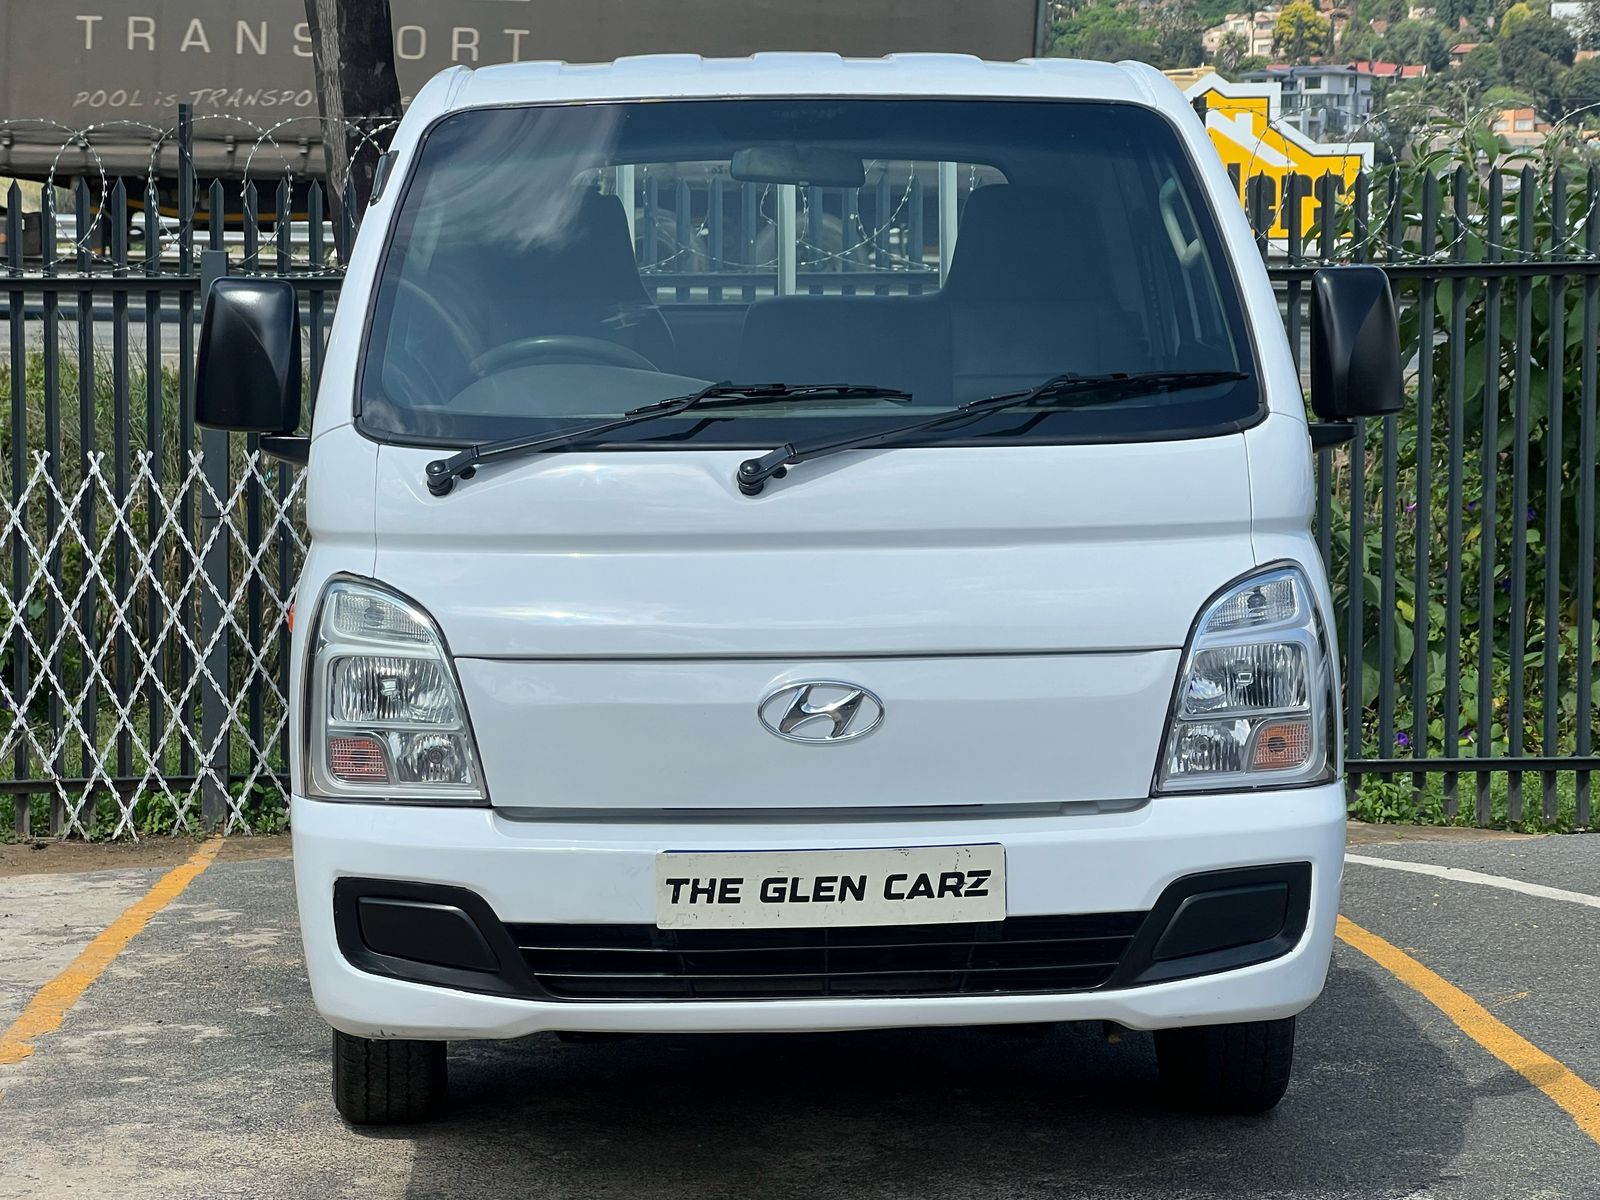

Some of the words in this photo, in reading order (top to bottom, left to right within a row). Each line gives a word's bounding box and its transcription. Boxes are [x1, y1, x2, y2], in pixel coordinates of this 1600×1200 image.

[76, 15, 530, 63] TRANSORT
[72, 89, 143, 108] POOL
[189, 88, 318, 108] TRANSPO
[665, 877, 744, 905] THE
[759, 874, 868, 904] GLEN
[883, 869, 992, 901] CARZ
